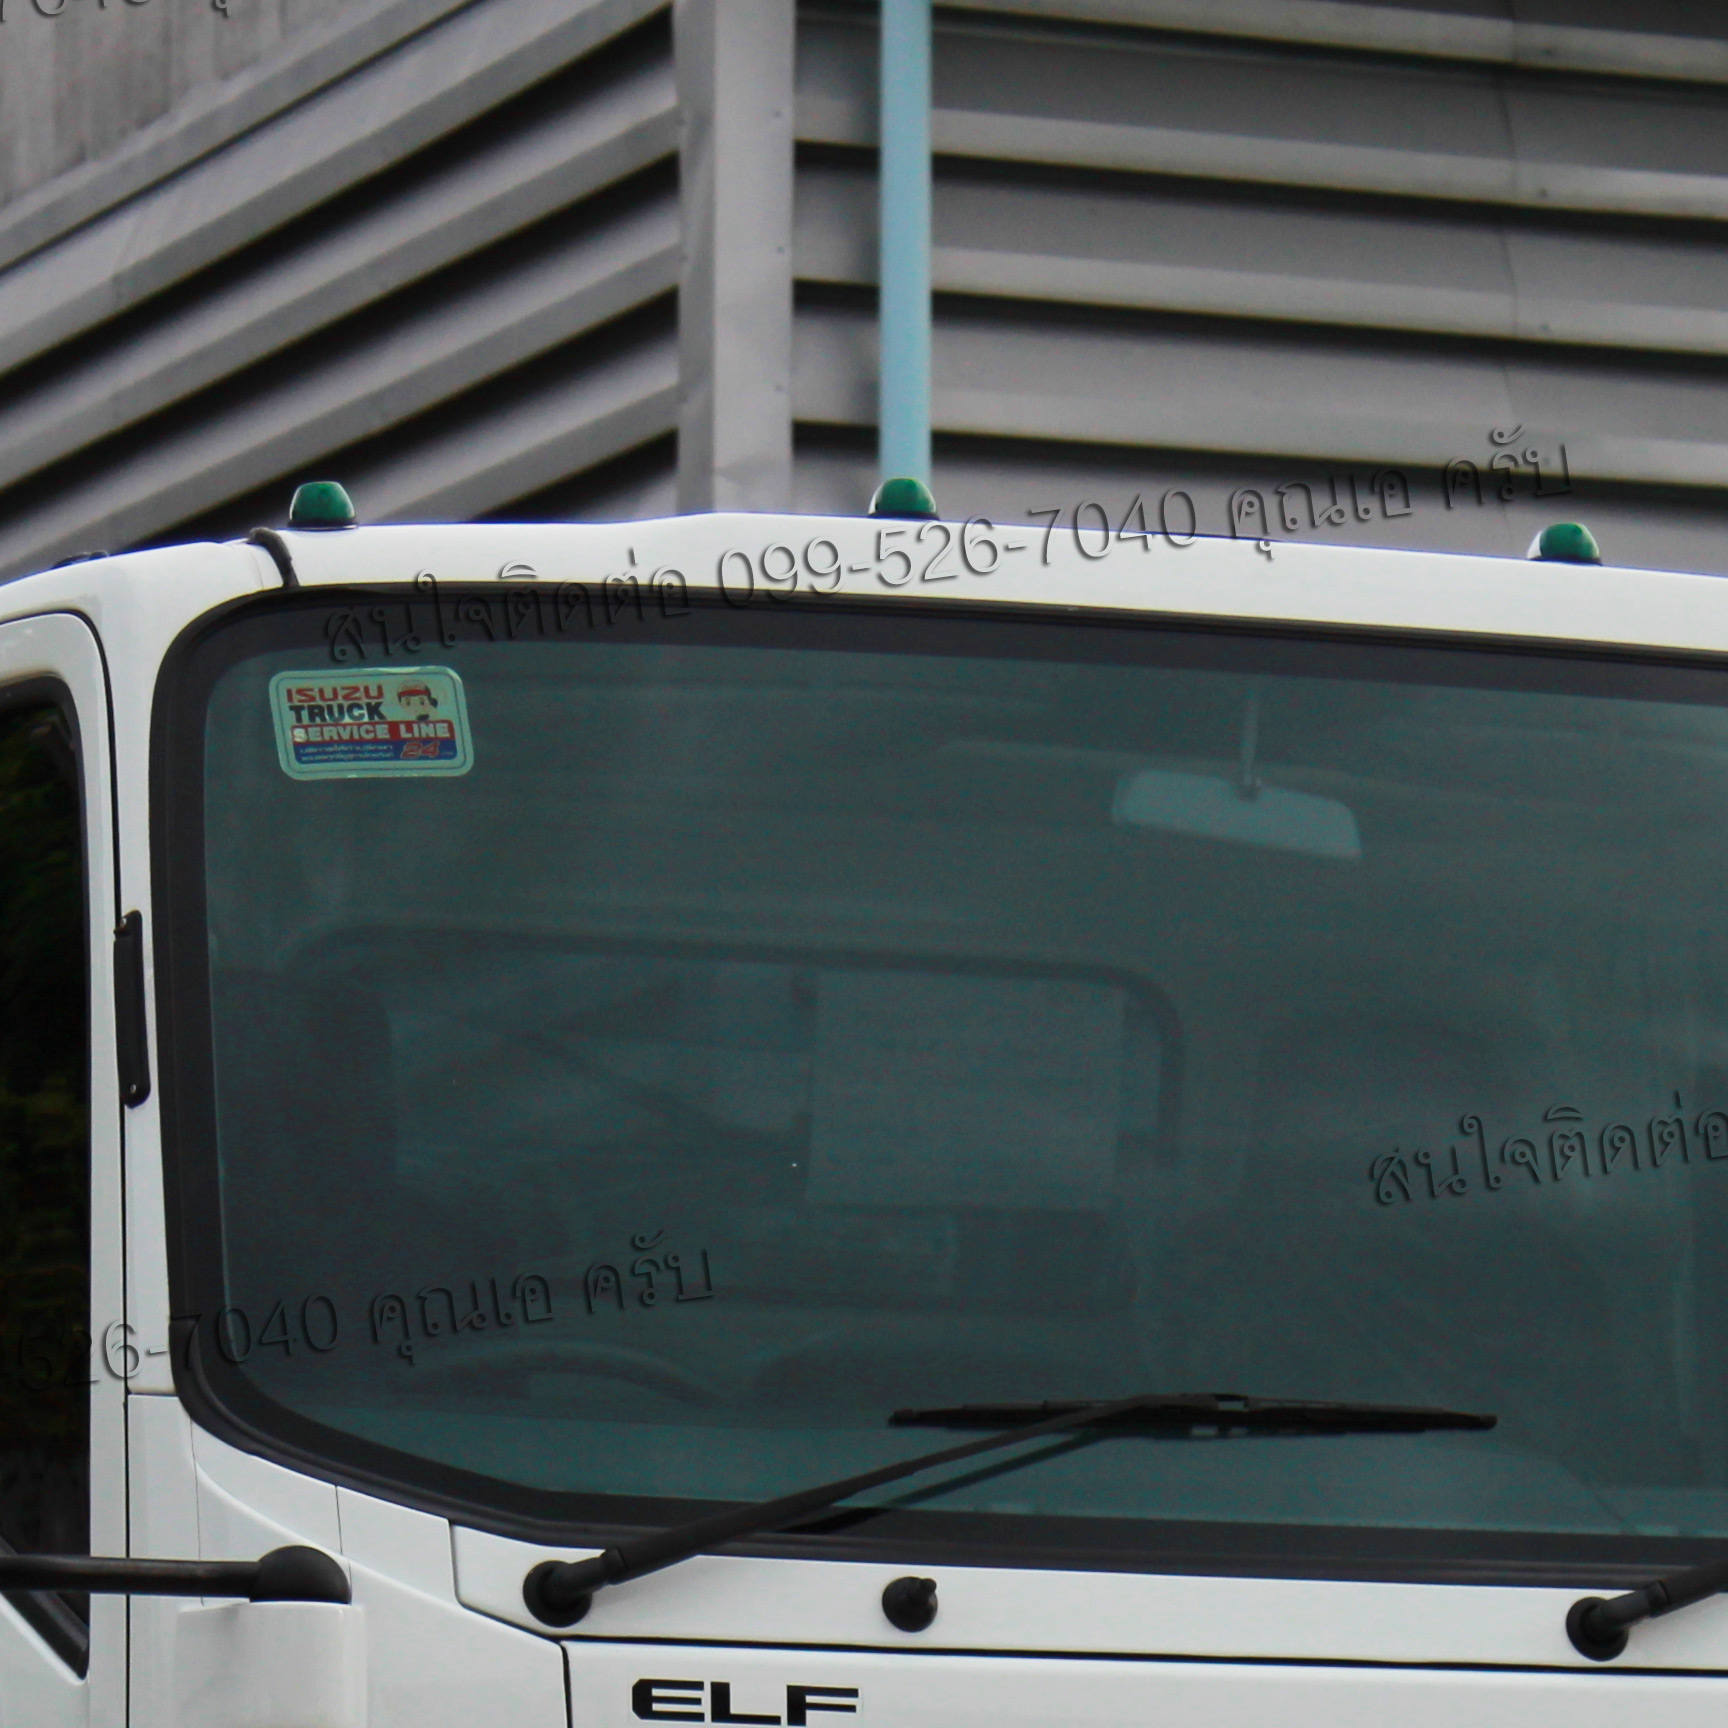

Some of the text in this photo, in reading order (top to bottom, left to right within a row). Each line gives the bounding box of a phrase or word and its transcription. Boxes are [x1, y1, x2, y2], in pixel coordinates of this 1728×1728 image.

[286, 684, 384, 704] ISUZU
[288, 702, 387, 724] TRUCK
[292, 722, 451, 743] SERVICE LINE
[632, 1678, 860, 1727] ELF
